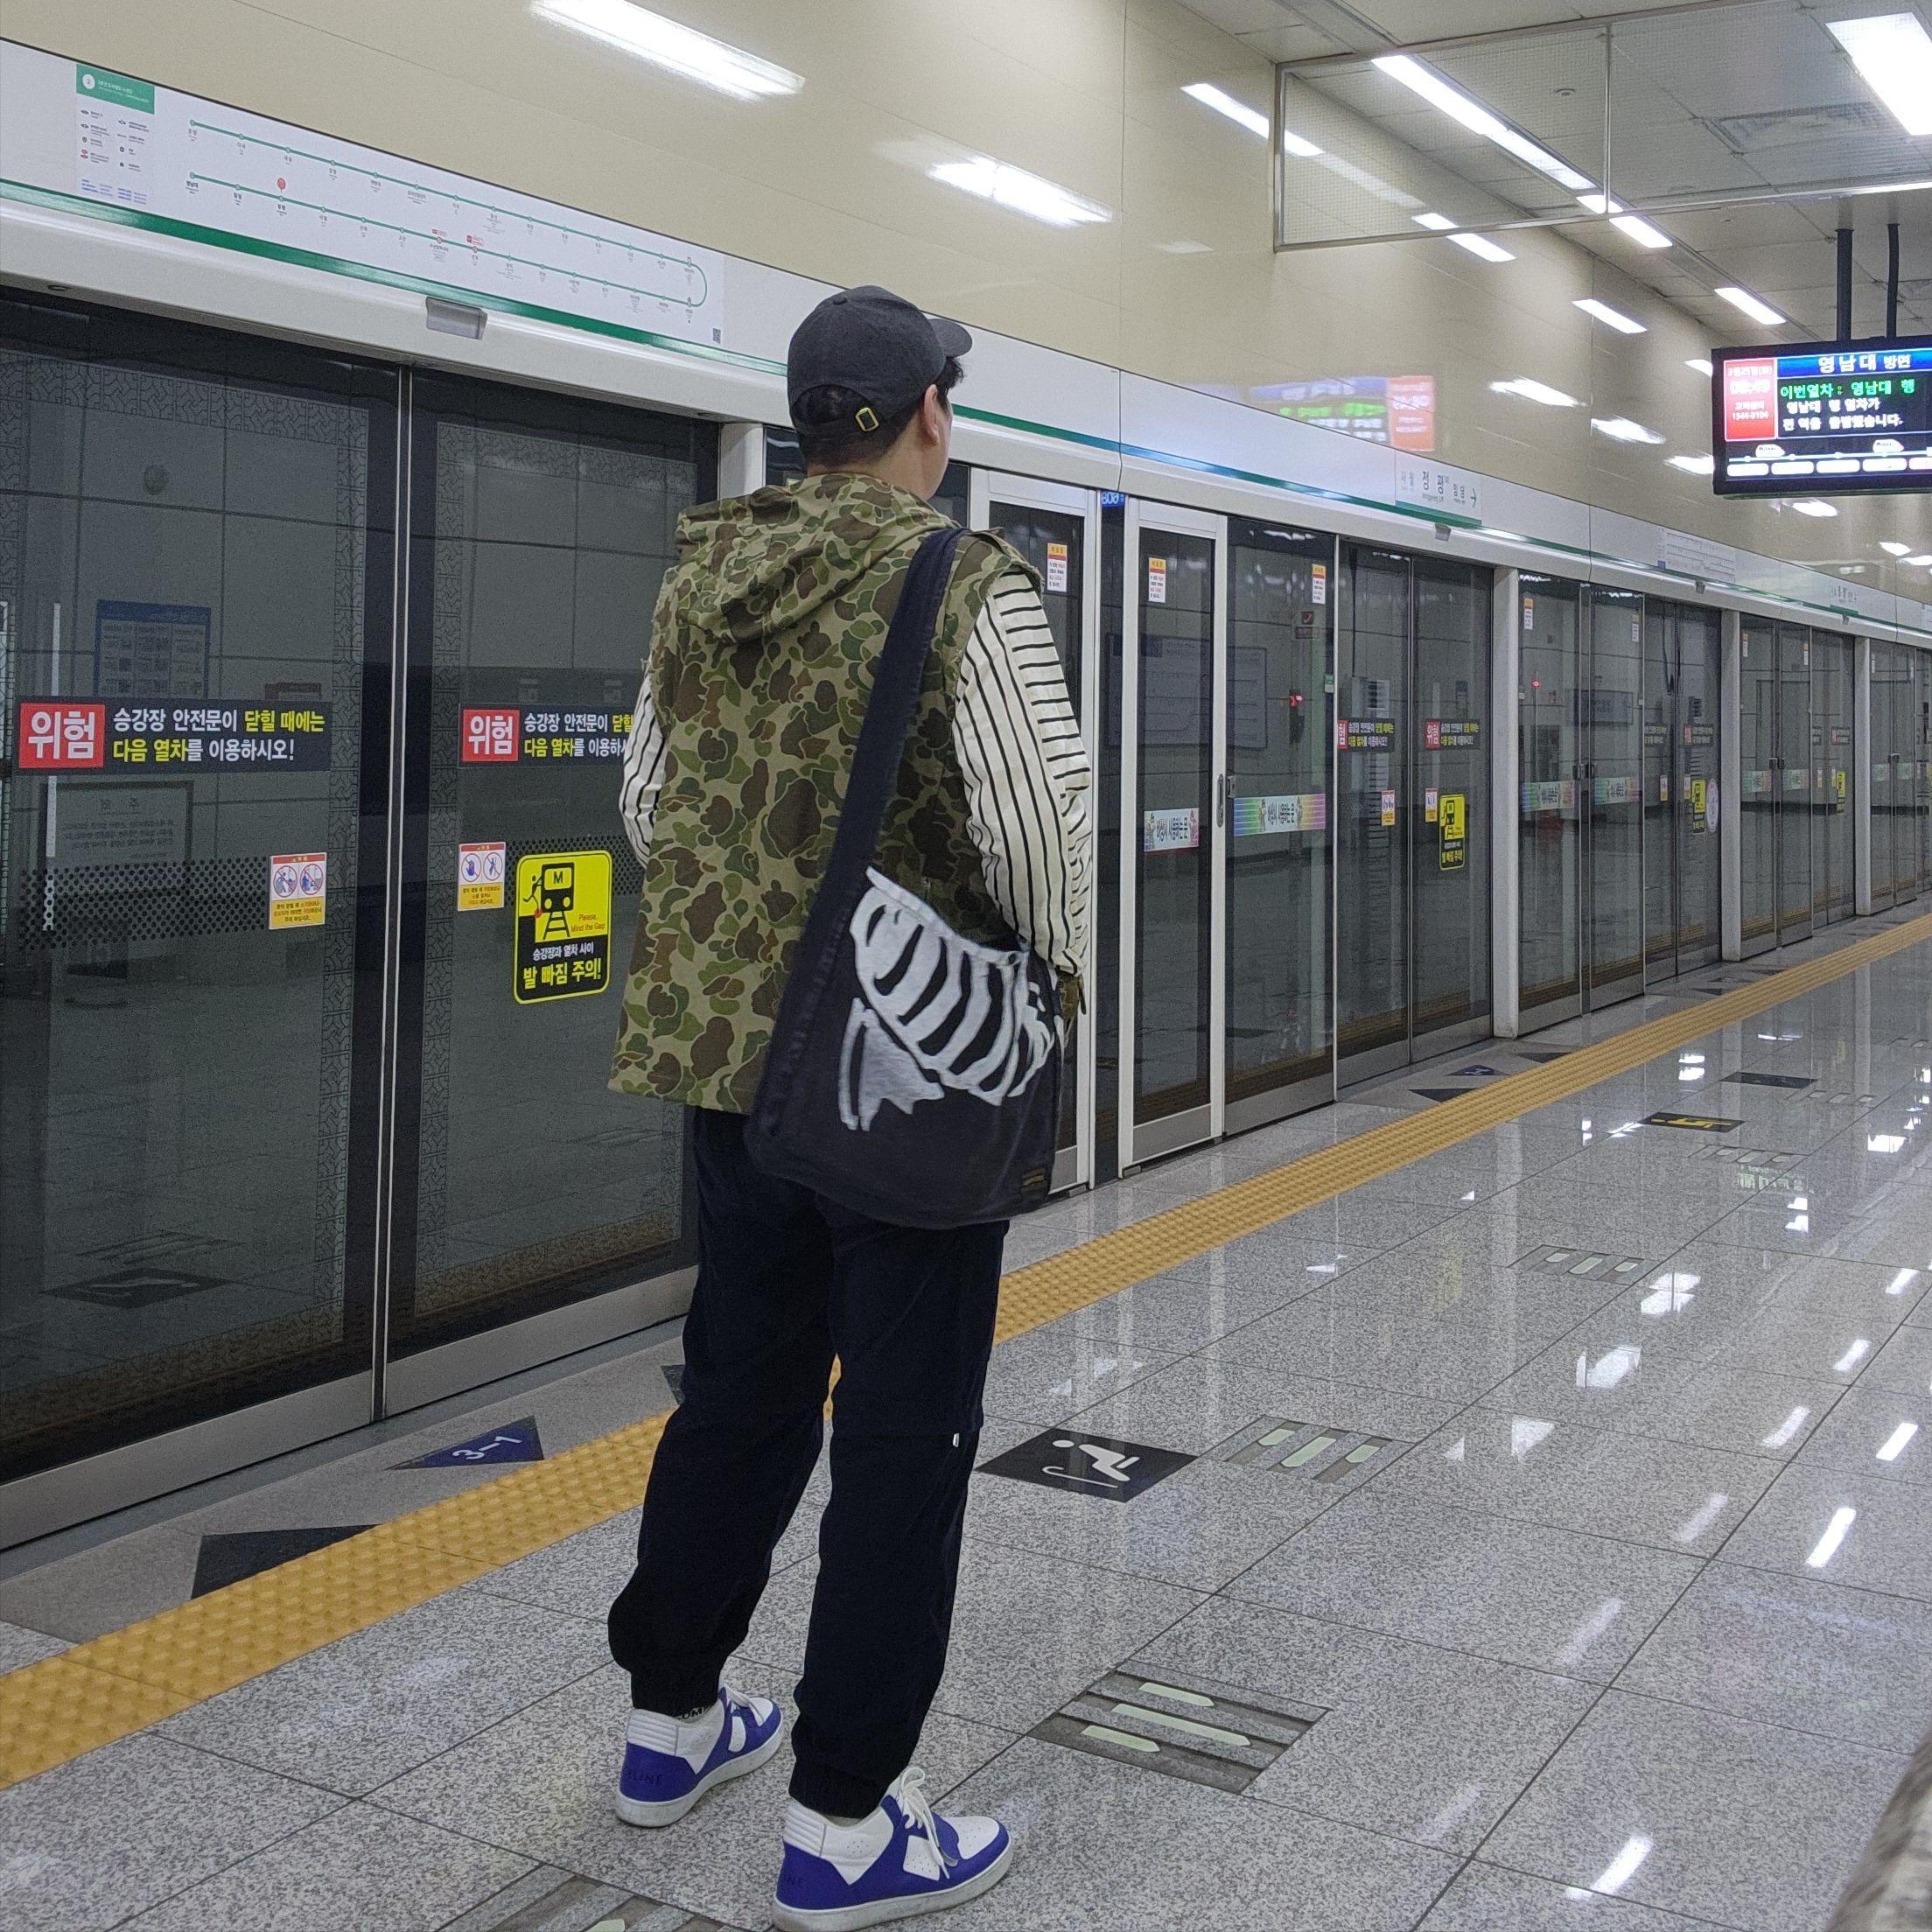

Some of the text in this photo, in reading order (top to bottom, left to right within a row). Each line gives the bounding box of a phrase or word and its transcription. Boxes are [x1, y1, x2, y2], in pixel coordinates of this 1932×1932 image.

[1818, 354, 1911, 374] 영남대 방면
[1780, 382, 1834, 400] 이번열차
[1851, 380, 1892, 396] 영남대
[1900, 379, 1914, 394] 행
[113, 707, 326, 733] 승강장 안전문이 닫힐 때에는
[525, 713, 634, 732] 승강장 안전문이 닫힐
[28, 710, 96, 760] 위험
[468, 715, 514, 755] 위험
[113, 738, 295, 762] 다음 열차를 이용하시오!
[525, 738, 548, 758] 다음
[551, 738, 584, 757] 열차를
[553, 871, 564, 885] M
[594, 921, 606, 931] Gap
[532, 942, 594, 960] 승강장과 열차 사이
[522, 957, 602, 990] 발 빠짐 주의!
[452, 1434, 523, 1461] 3-1
